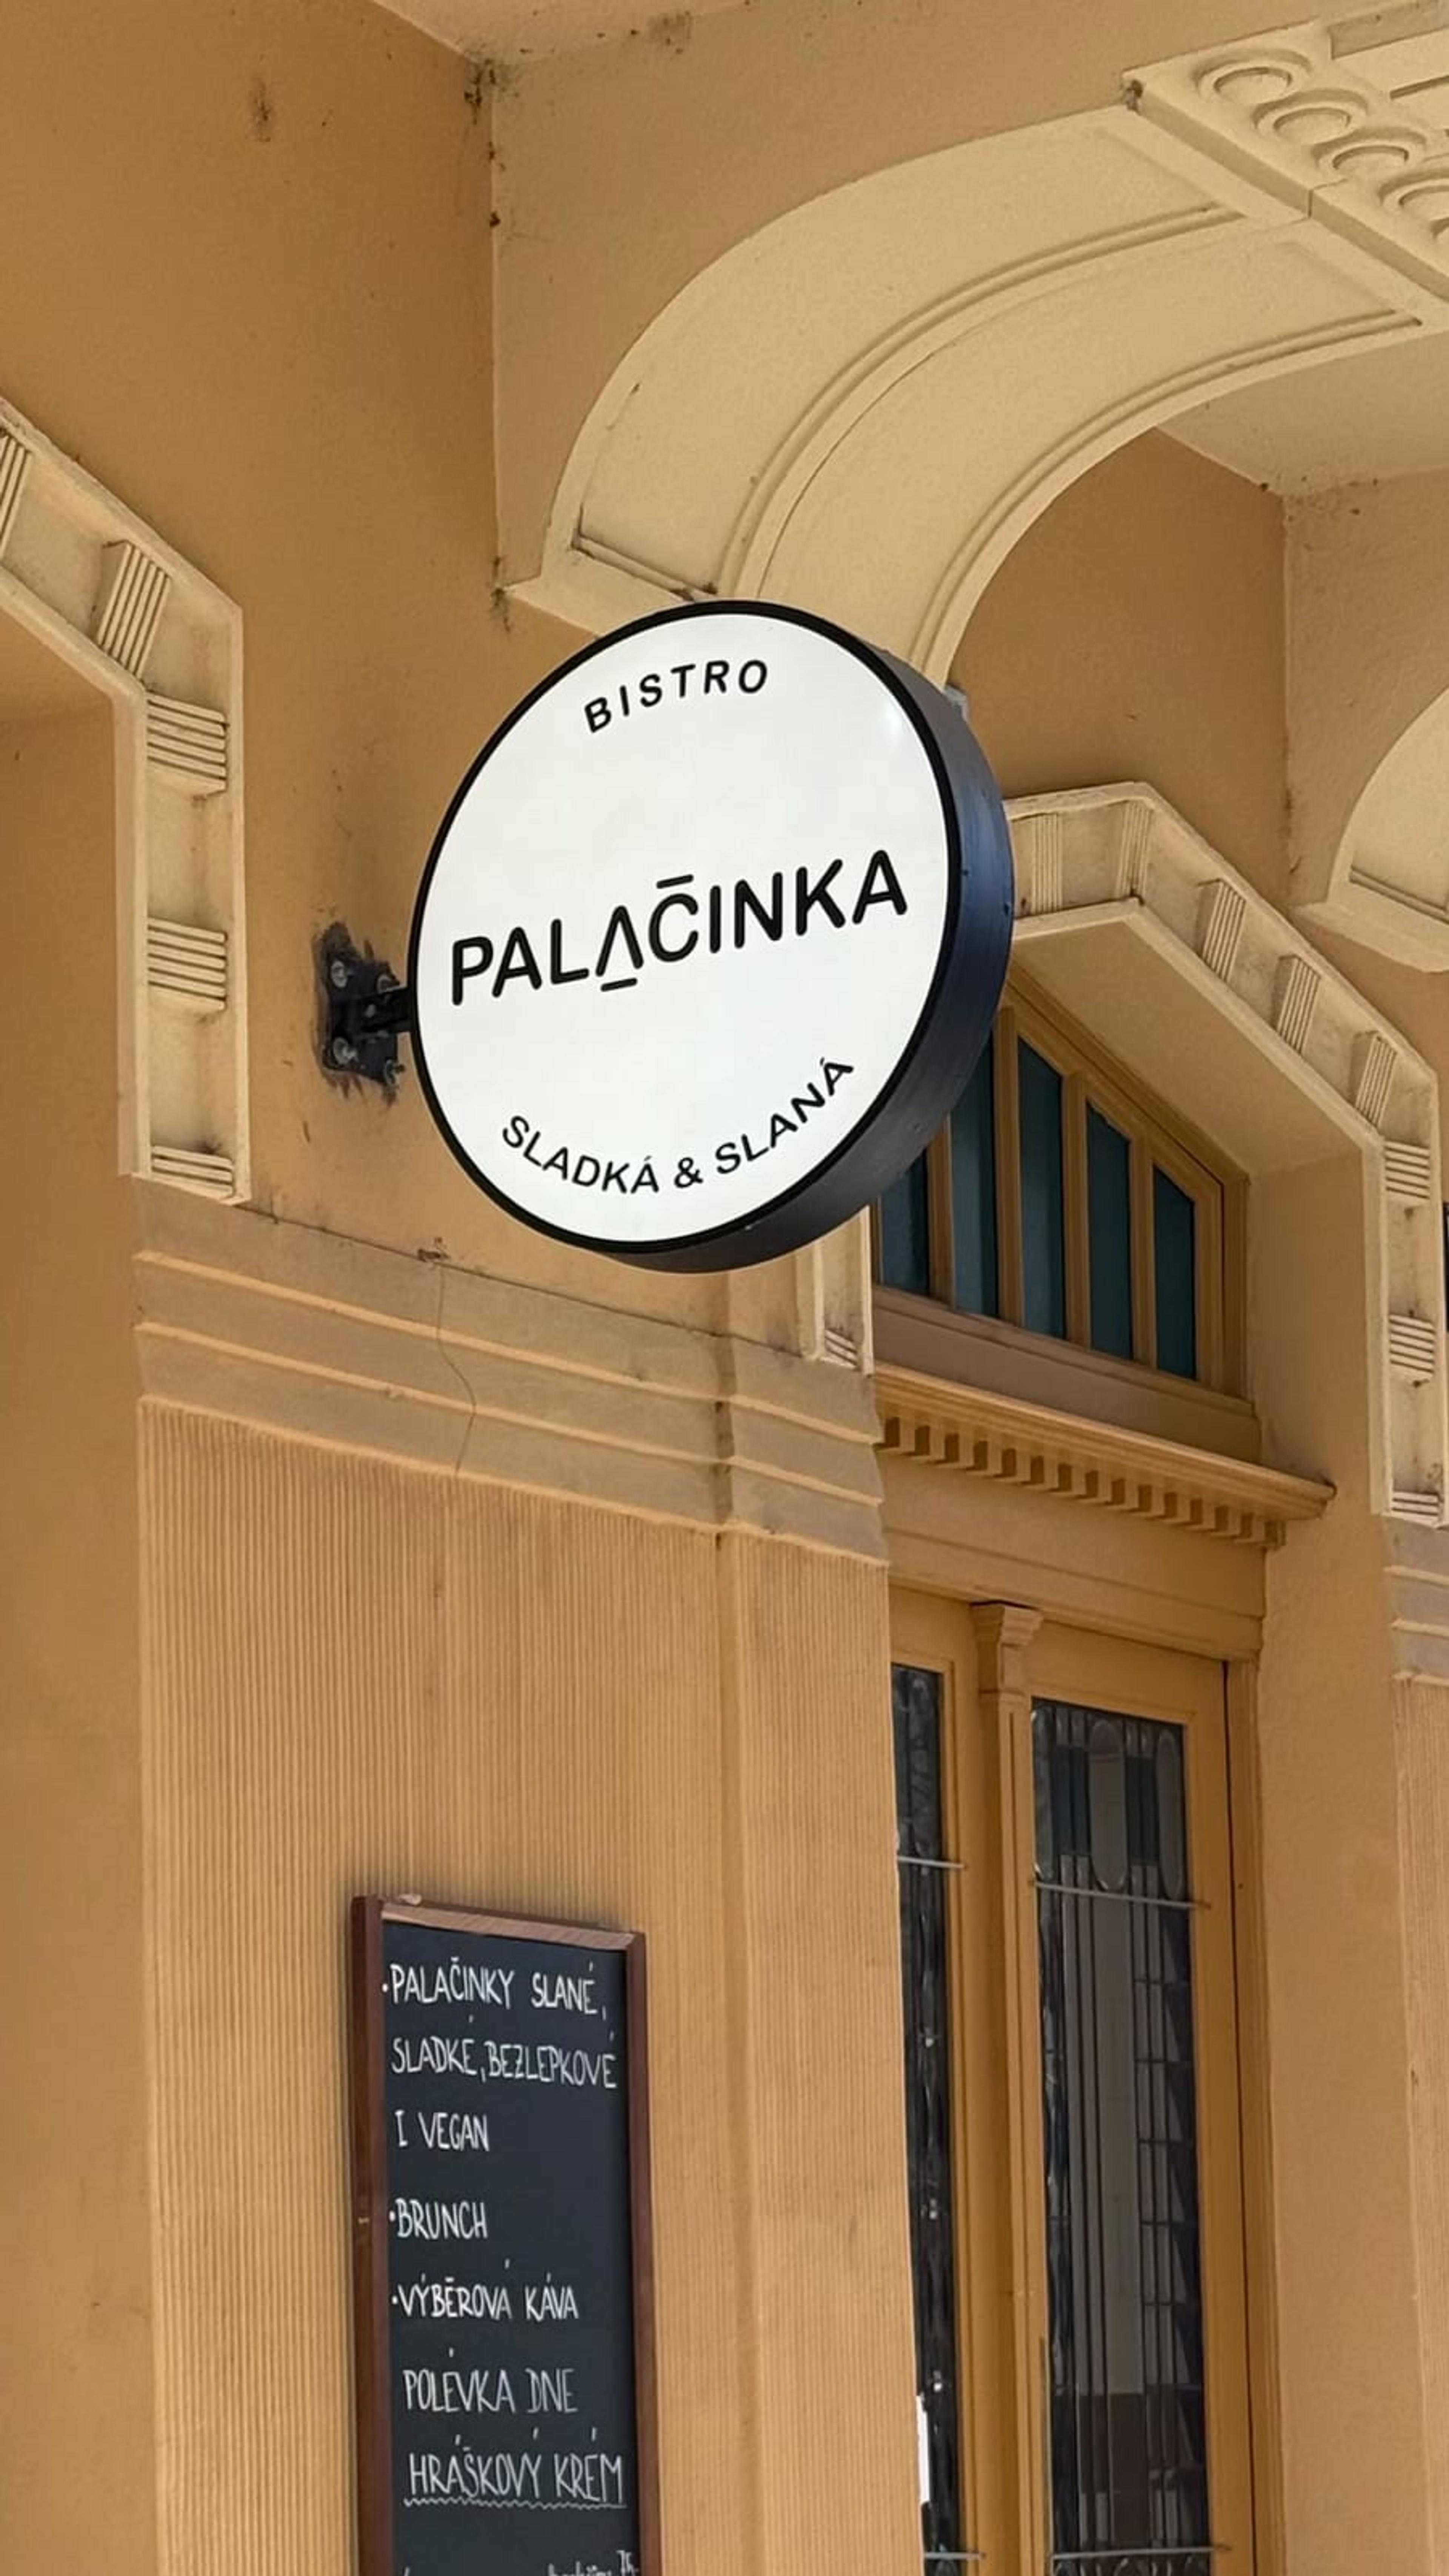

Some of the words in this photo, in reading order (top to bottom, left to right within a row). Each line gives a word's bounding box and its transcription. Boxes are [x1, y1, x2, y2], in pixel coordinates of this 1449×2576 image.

[584, 660, 768, 733] BISTRO
[502, 1115, 660, 1194] SLADKÁ
[674, 1157, 703, 1189] &
[715, 1057, 854, 1174] SLANÁ
[530, 1961, 607, 2021] SLANÉ,
[394, 2109, 408, 2147] I
[418, 2111, 490, 2152] VEGAN
[395, 2197, 488, 2240] BRUNCH
[525, 2273, 580, 2322] KÁVA
[403, 2348, 516, 2413] POLÉVKA
[525, 2368, 578, 2413] DNE
[409, 2427, 542, 2499] HRÁŠKOVÝ
[553, 2427, 623, 2504] KRÉM
